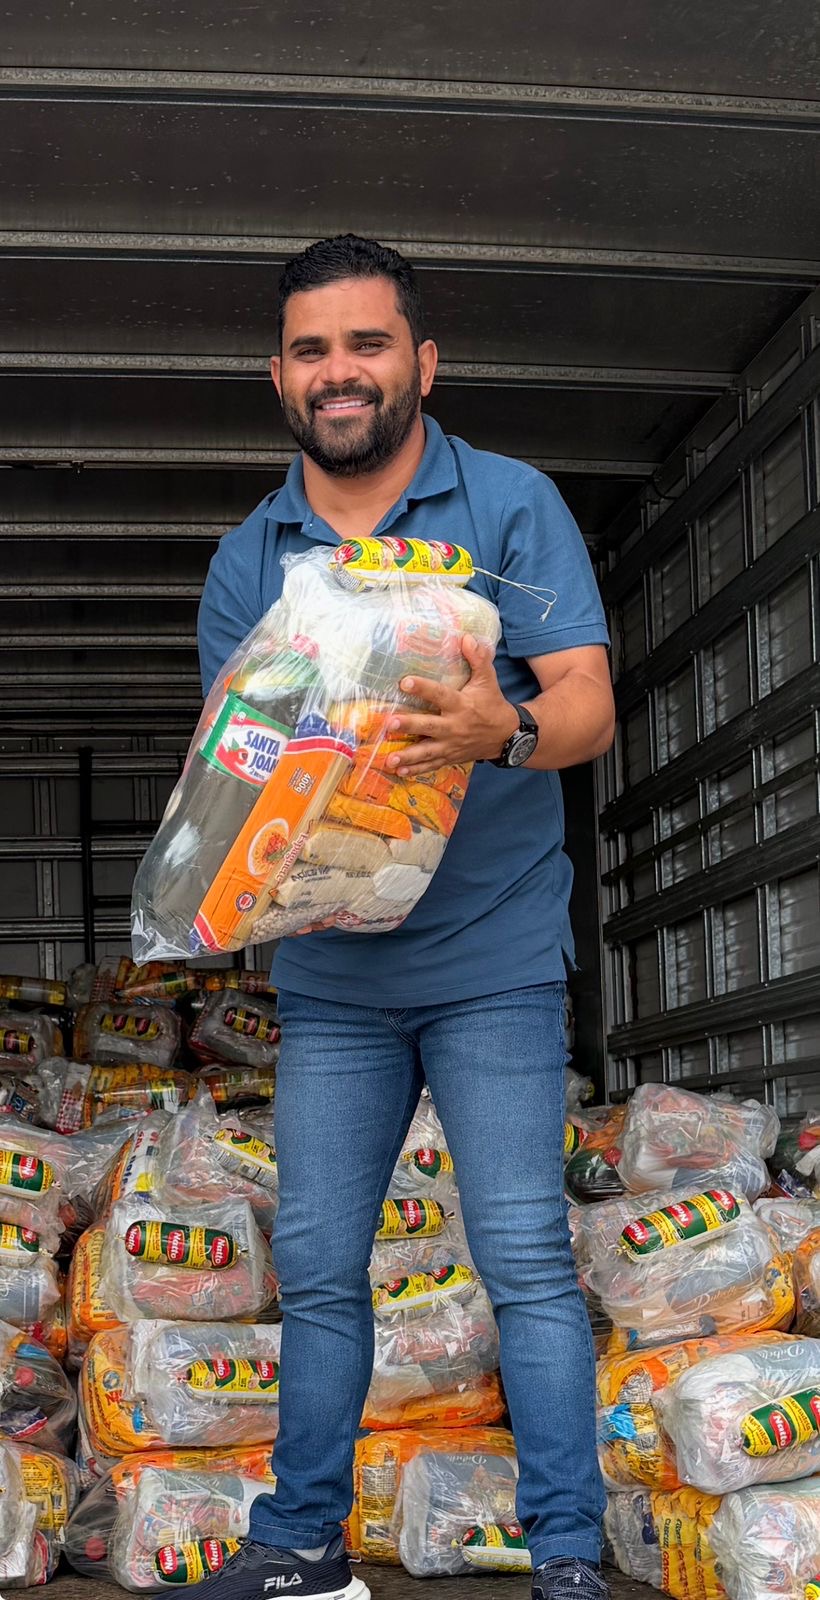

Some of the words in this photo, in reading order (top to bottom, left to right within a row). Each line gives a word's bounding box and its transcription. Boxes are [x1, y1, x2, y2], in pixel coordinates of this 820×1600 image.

[244, 730, 281, 757] SANTA
[293, 773, 311, 793] 400g
[406, 1200, 416, 1224] Natto
[127, 1227, 138, 1250] Natto
[170, 1232, 182, 1259] Natto
[215, 1238, 226, 1264] Natto
[772, 1415, 788, 1446] Natto
[163, 1546, 174, 1571] Natto
[209, 1539, 219, 1566] Natto
[263, 1572, 303, 1592] FILA
